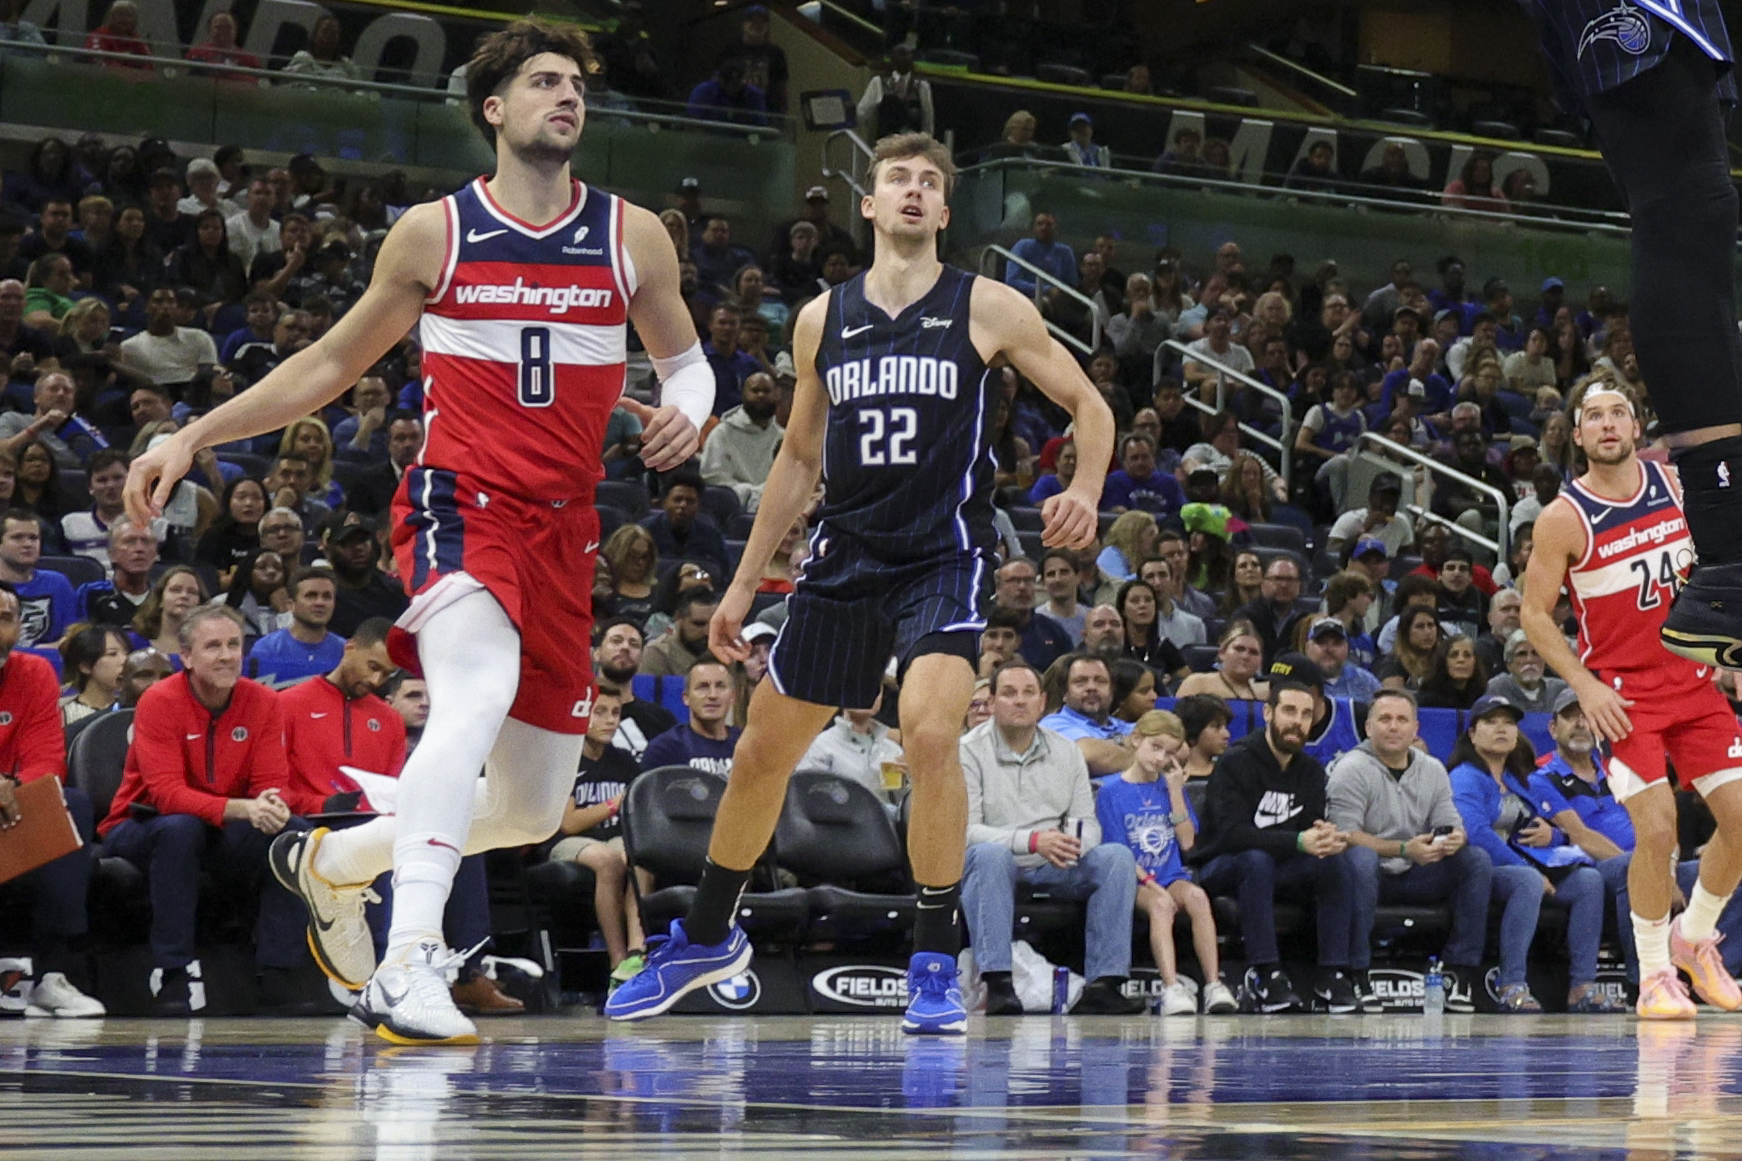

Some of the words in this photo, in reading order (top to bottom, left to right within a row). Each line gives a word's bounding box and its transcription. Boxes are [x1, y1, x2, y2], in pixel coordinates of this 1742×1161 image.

[456, 276, 612, 314] washington
[919, 317, 953, 329] Disney
[518, 326, 555, 407] 8
[826, 355, 958, 406] ORLANDO
[859, 407, 918, 465] 22
[1598, 517, 1685, 559] washington
[1630, 550, 1681, 611] 24
[836, 977, 909, 996] FIELDS
